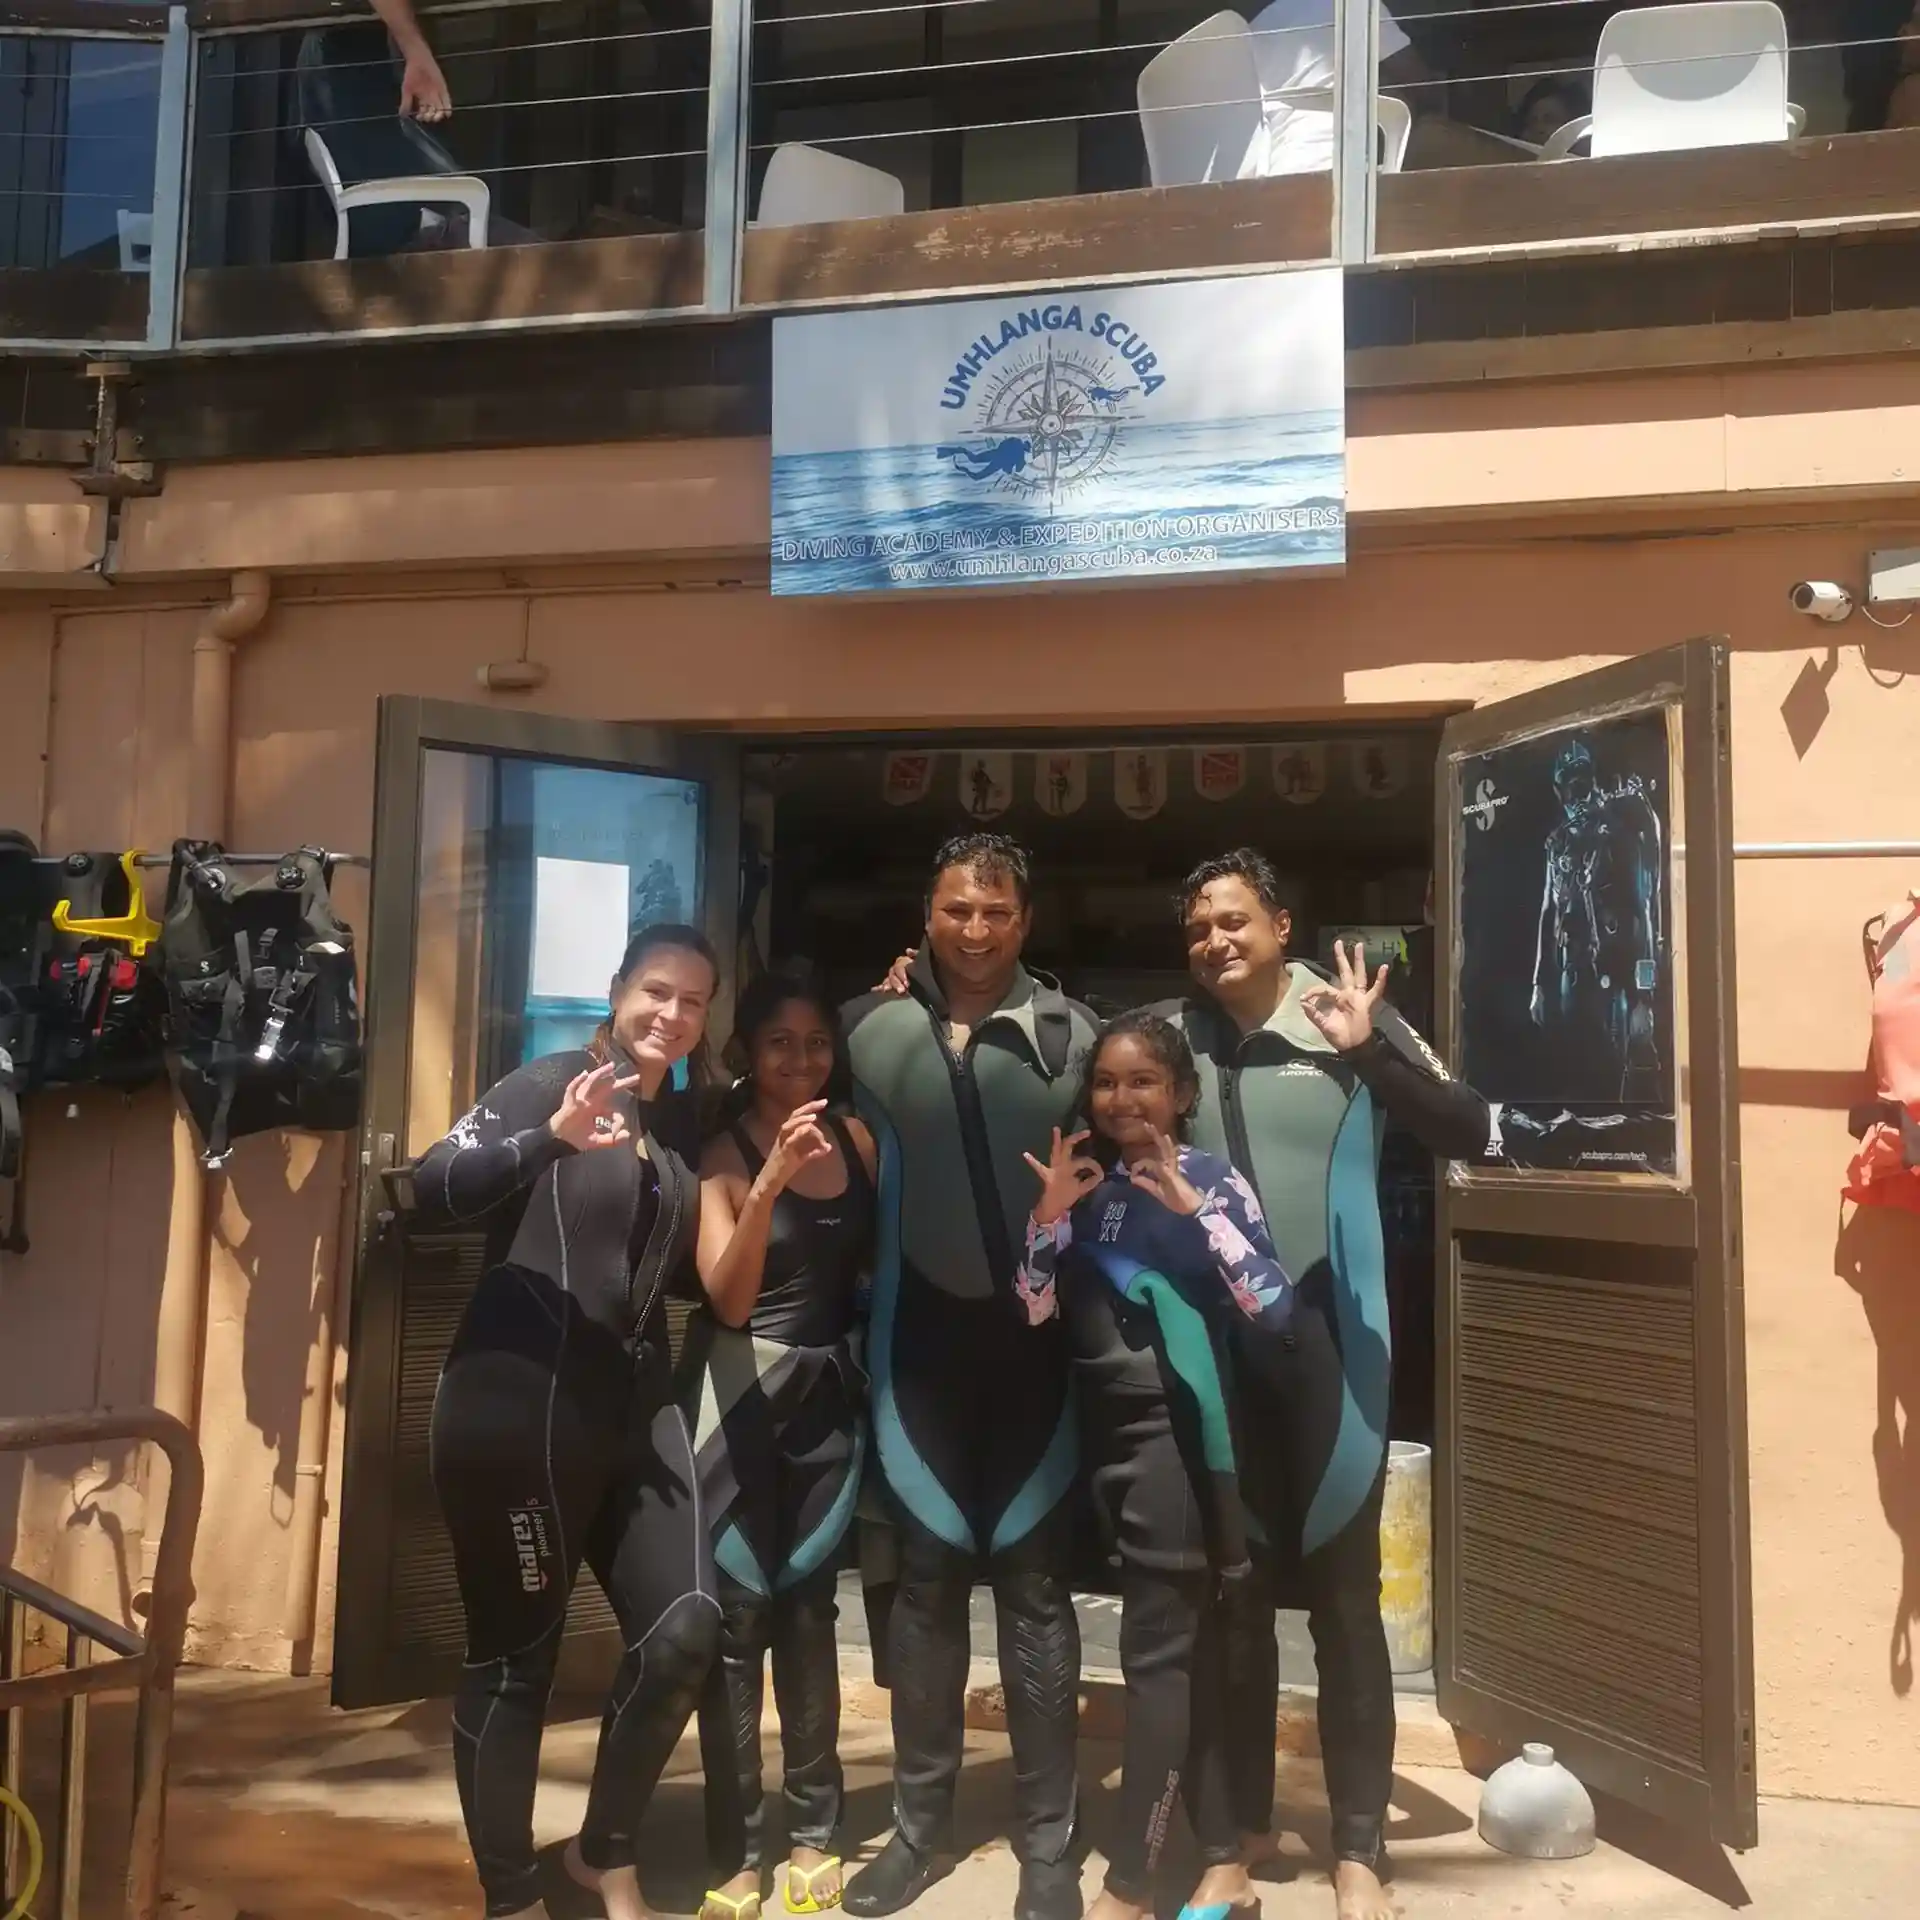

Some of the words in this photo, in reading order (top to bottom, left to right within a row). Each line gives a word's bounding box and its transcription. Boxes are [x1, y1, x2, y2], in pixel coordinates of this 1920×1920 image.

[940, 304, 1083, 410] UMHLANGA
[1089, 311, 1167, 398] SCUBA
[781, 534, 865, 561] DIVING
[869, 527, 993, 556] ACADEMY
[996, 526, 1015, 549] &
[1020, 518, 1170, 546] EXPEDITION
[1175, 506, 1339, 537] ORGANISERS
[889, 545, 1218, 580] www.umhlangascuba.co.za
[509, 1513, 540, 1591] mares
[532, 1511, 553, 1556] pioneer
